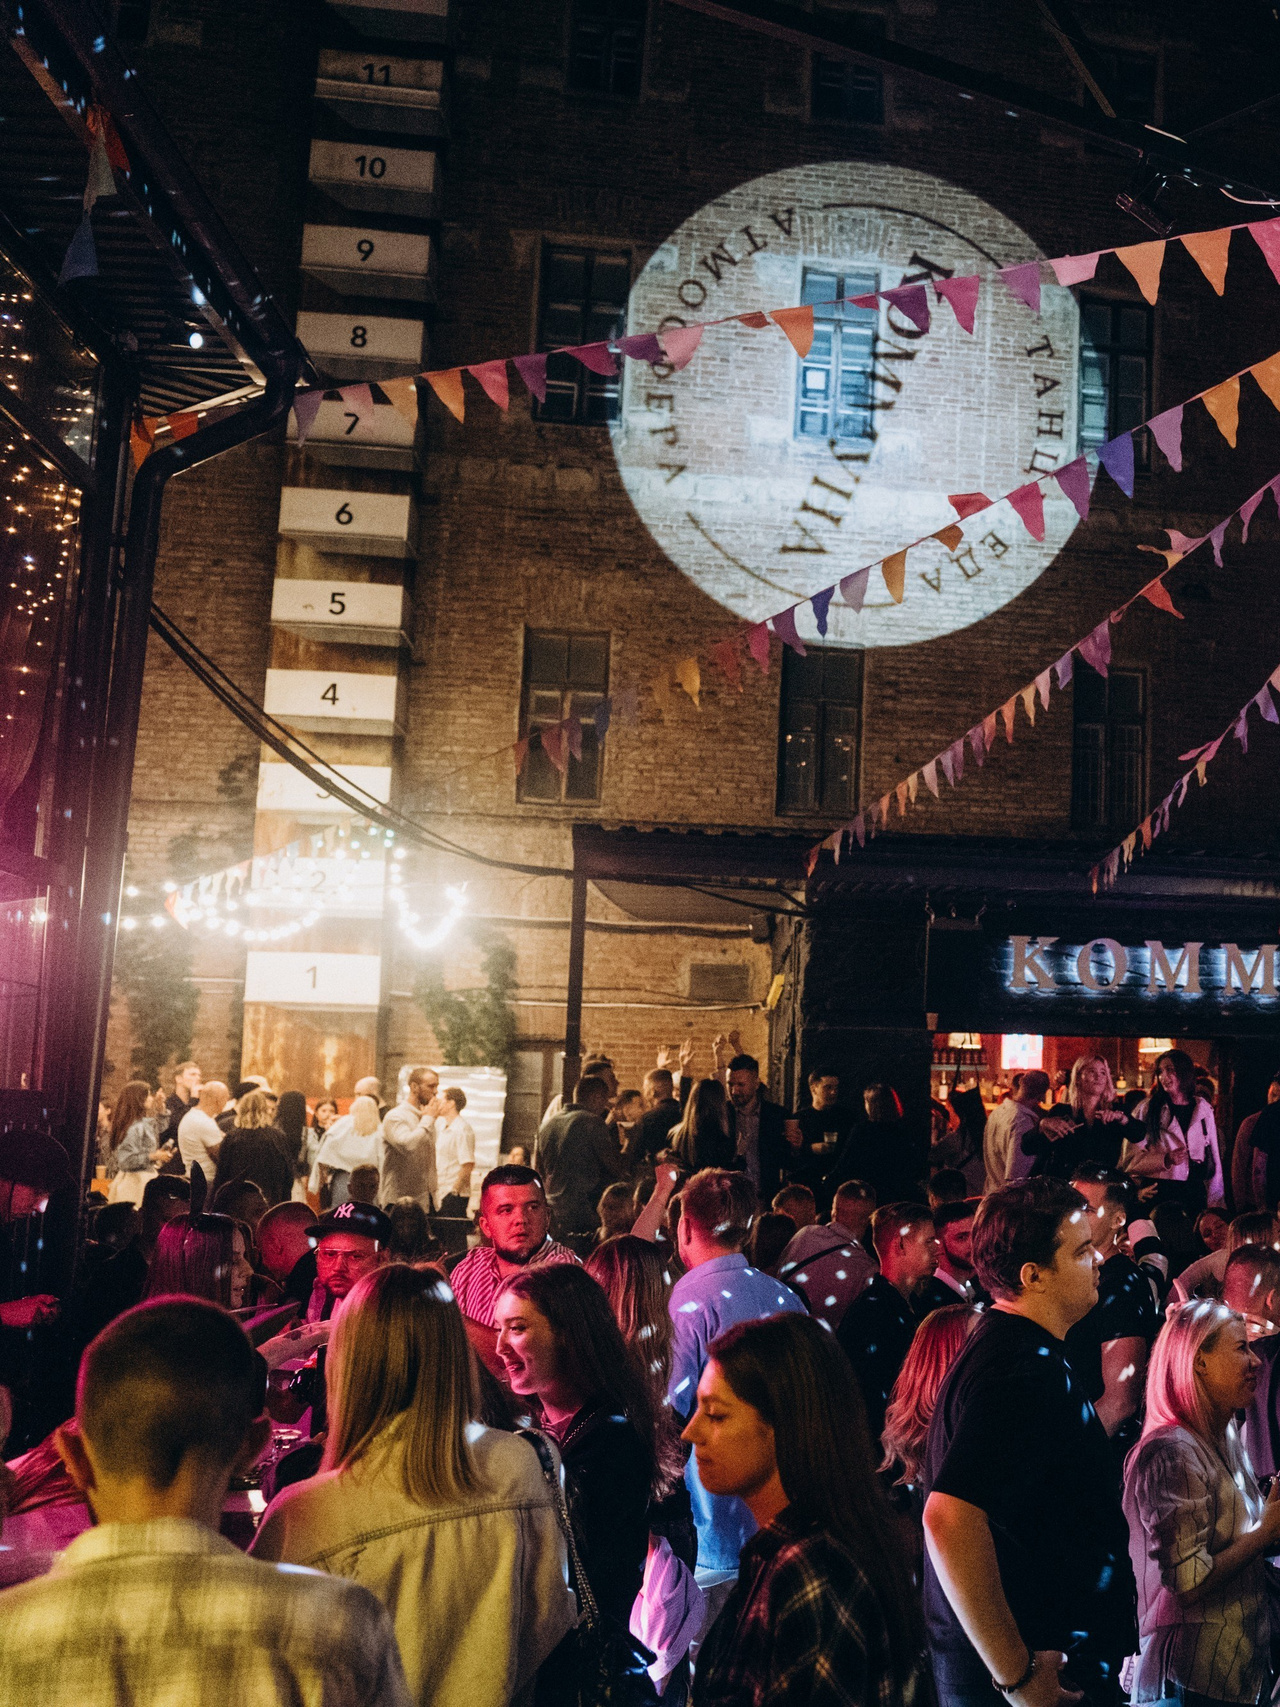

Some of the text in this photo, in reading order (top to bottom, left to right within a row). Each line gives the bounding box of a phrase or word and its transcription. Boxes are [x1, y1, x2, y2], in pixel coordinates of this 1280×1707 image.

[361, 63, 391, 86] 11
[354, 155, 387, 179] 10
[356, 239, 374, 262] 9
[350, 326, 368, 349] 8
[343, 413, 360, 436] 7
[1022, 335, 1066, 502] ТАНЦ
[335, 503, 353, 526] 6
[919, 530, 1011, 593] ЕДА
[328, 592, 346, 616] 5
[320, 683, 339, 706] 4
[311, 871, 326, 893] 2
[306, 965, 318, 989] 1
